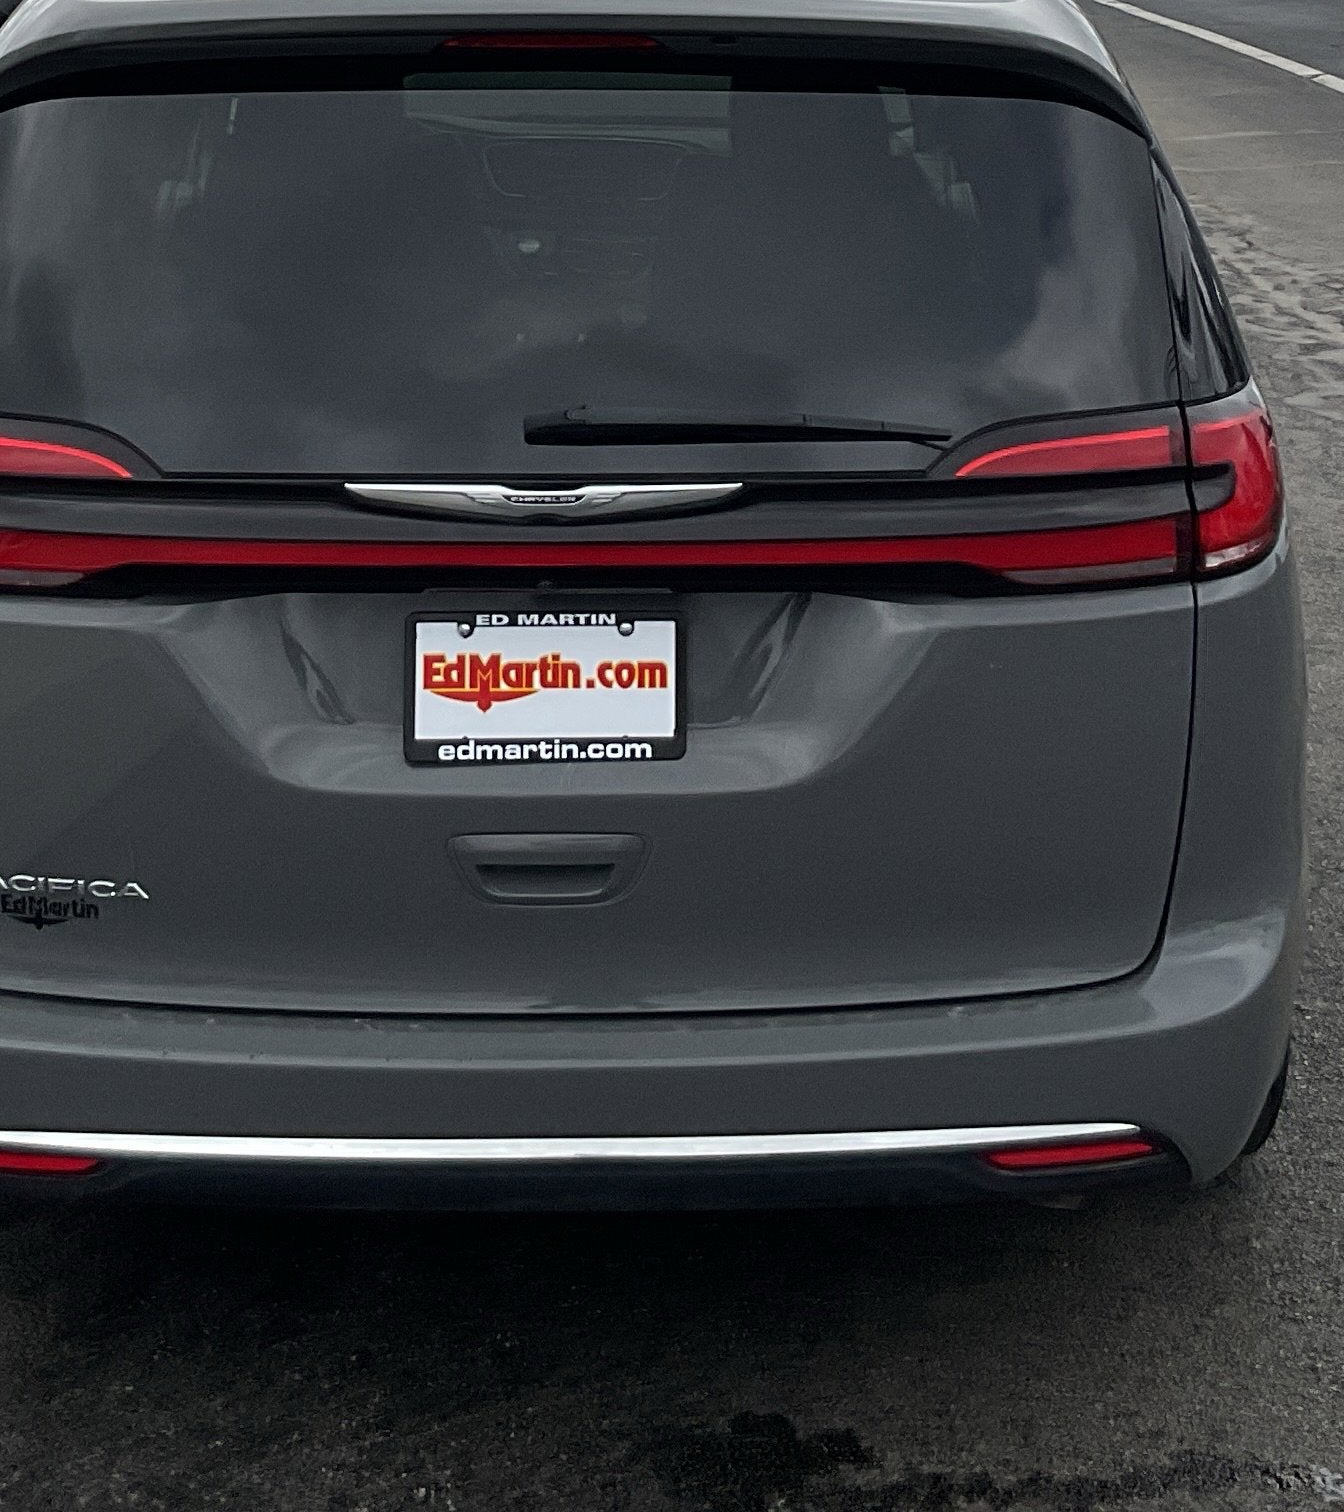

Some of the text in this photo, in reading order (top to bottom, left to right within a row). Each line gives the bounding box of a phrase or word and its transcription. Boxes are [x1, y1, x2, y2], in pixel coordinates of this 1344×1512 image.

[475, 613, 617, 626] ED MARTIN
[422, 651, 669, 700] EdMartin.com
[438, 739, 653, 761] edmartin.com
[1, 893, 100, 922] EdMartin
